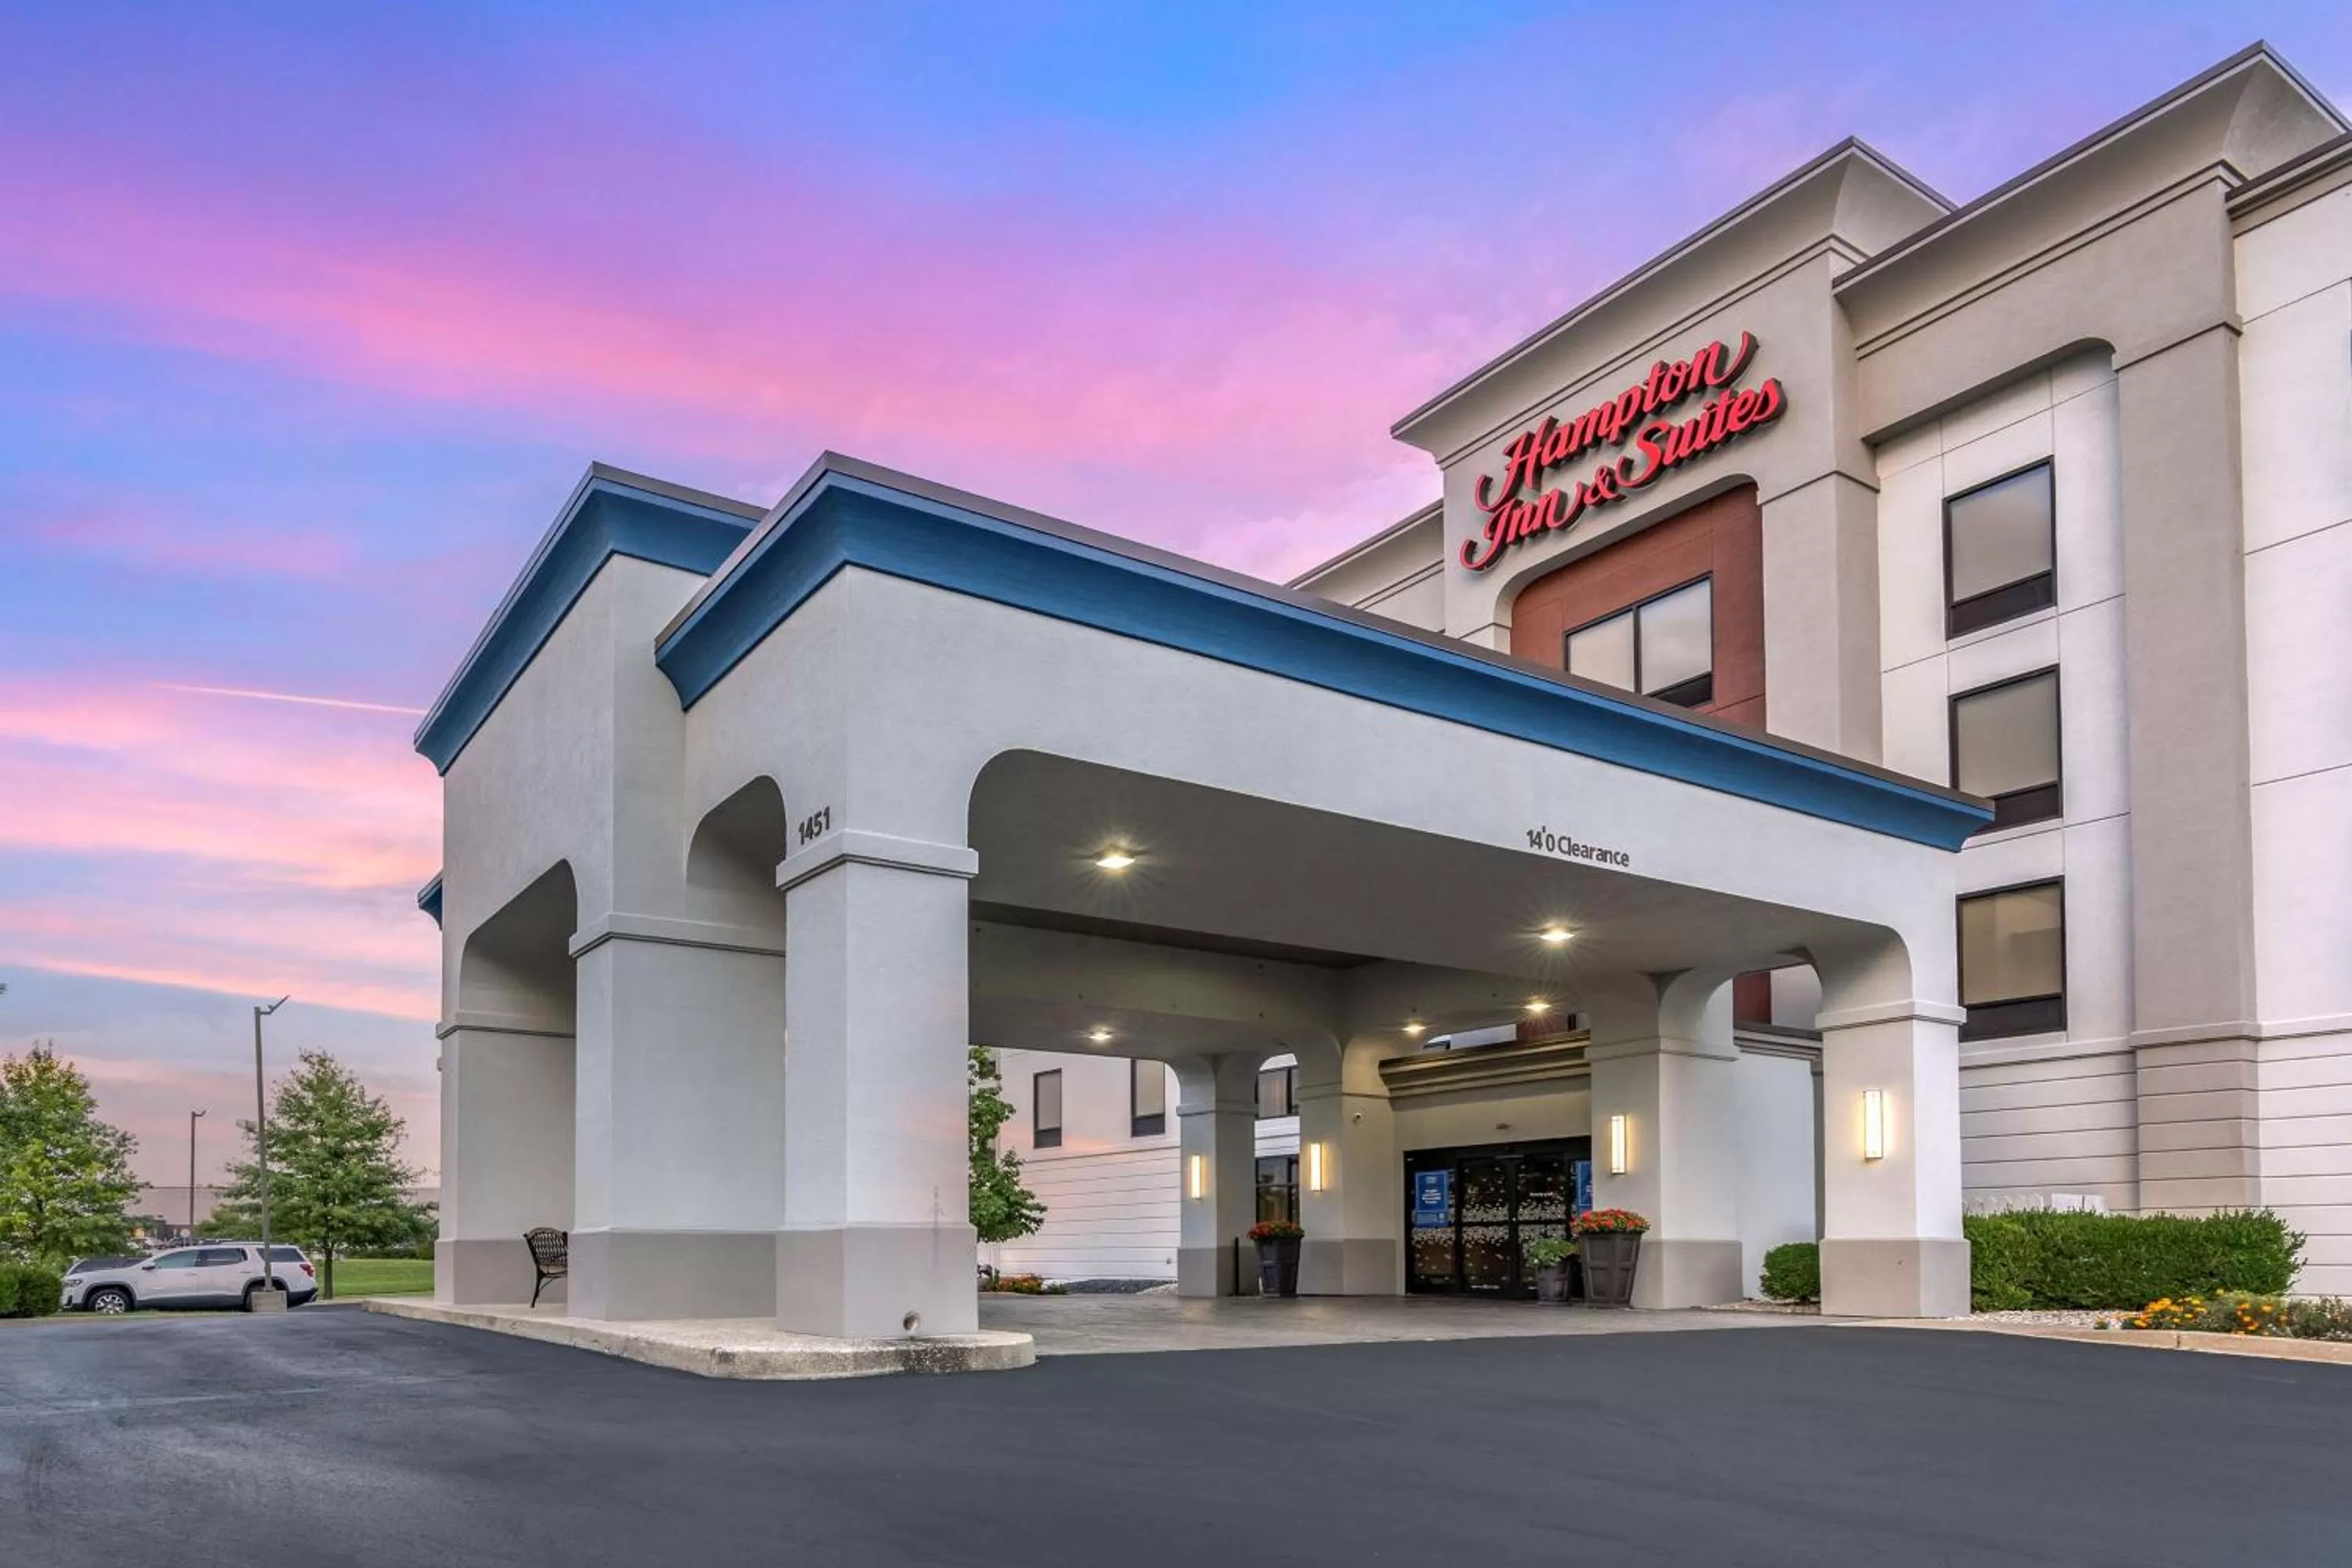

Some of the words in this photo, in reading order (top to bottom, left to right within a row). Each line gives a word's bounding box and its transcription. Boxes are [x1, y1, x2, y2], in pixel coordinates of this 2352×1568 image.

[1459, 481, 1586, 571] Inn
[1583, 464, 1623, 508] &
[1615, 377, 1788, 489] Suites
[1475, 330, 1759, 514] Hampton
[798, 805, 830, 846] 1451
[1557, 835, 1630, 867] Clearance
